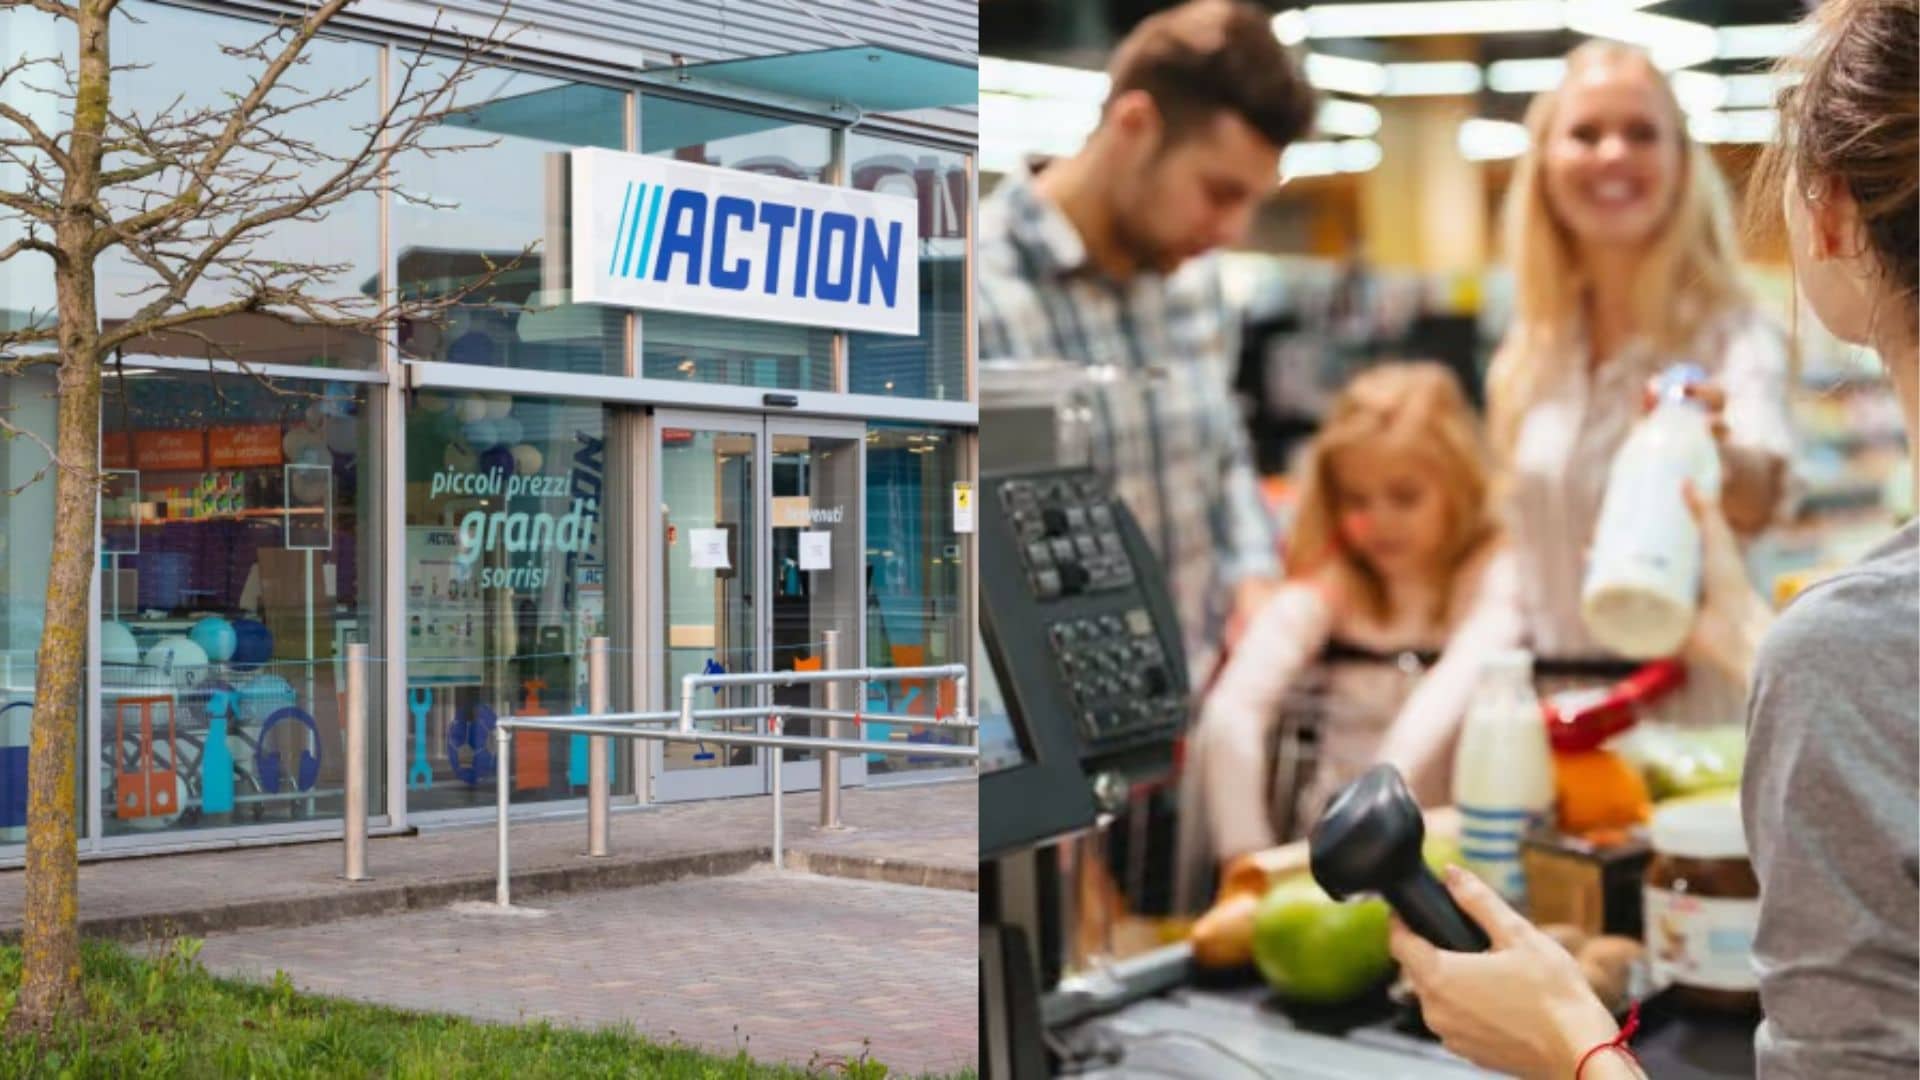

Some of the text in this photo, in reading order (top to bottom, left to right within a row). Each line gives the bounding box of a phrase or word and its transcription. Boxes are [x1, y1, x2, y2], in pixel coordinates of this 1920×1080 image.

[653, 188, 903, 309] ACTION
[431, 466, 573, 500] piccoli prezzi
[456, 499, 594, 565] grandi
[480, 559, 550, 589] sorrisi
